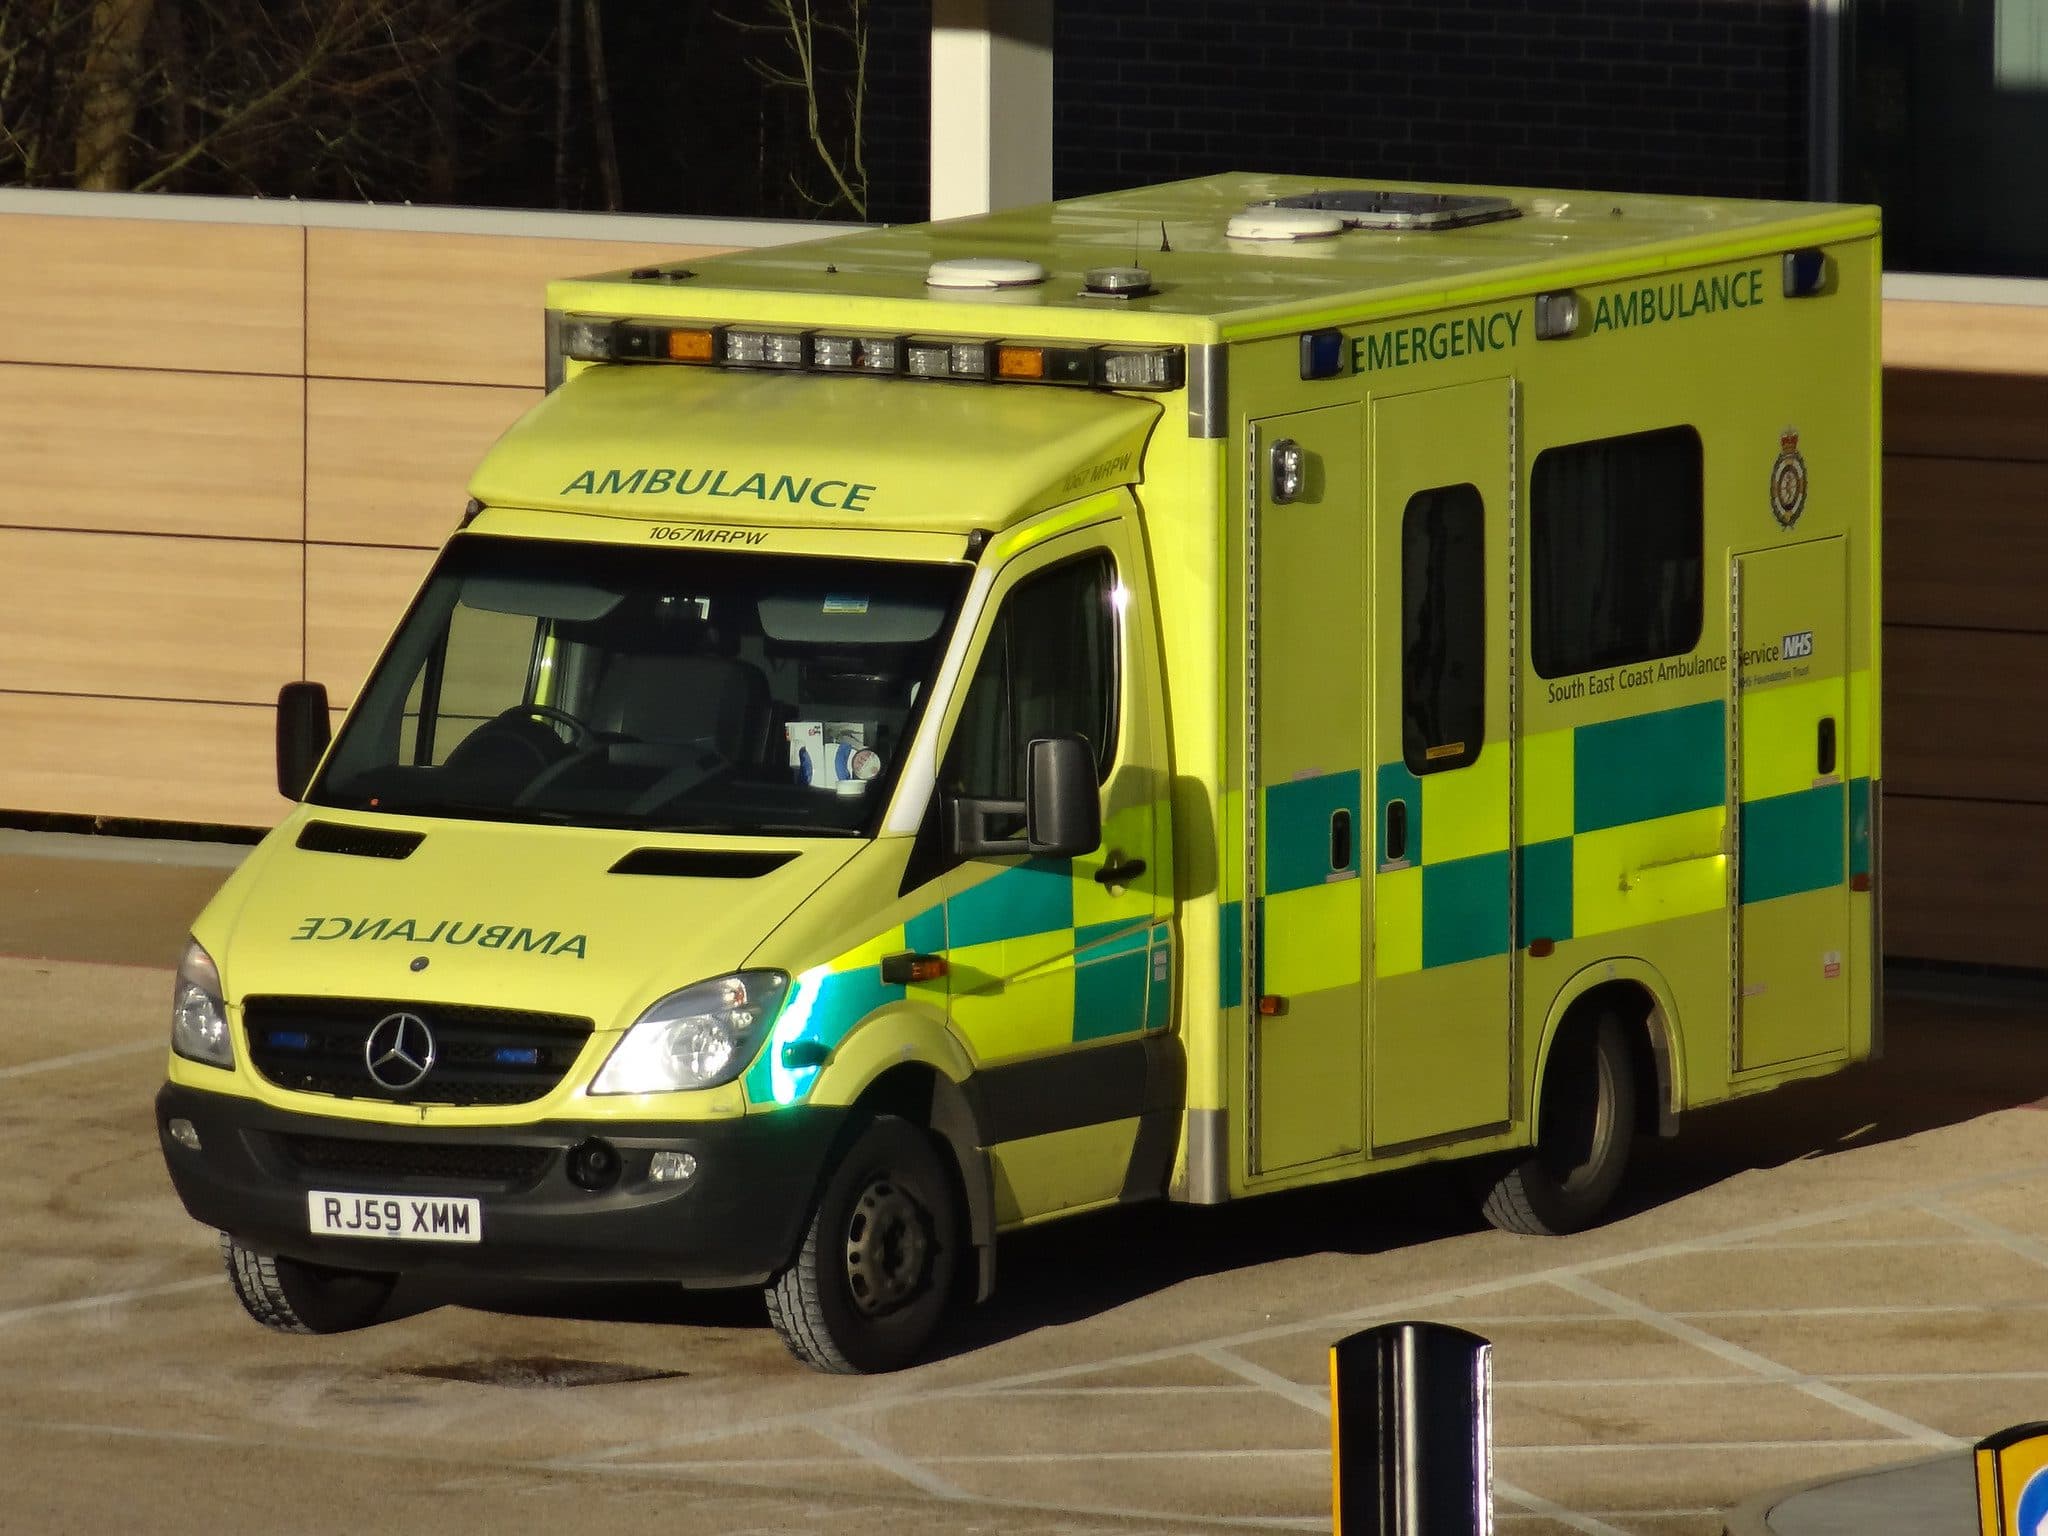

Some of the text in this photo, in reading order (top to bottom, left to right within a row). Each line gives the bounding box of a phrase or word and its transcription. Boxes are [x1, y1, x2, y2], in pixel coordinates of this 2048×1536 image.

[1351, 269, 1764, 375] EMERGENCY AMBULANCE
[560, 468, 877, 512] AMBULANCE
[649, 526, 768, 545] 1067MRPW
[1783, 631, 1813, 660] NHS
[1548, 677, 1585, 703] South
[1589, 672, 1615, 694] East
[1619, 666, 1654, 690] Coast
[1657, 654, 1727, 682] Ambulance
[324, 1197, 470, 1234] RJ59 XMM
